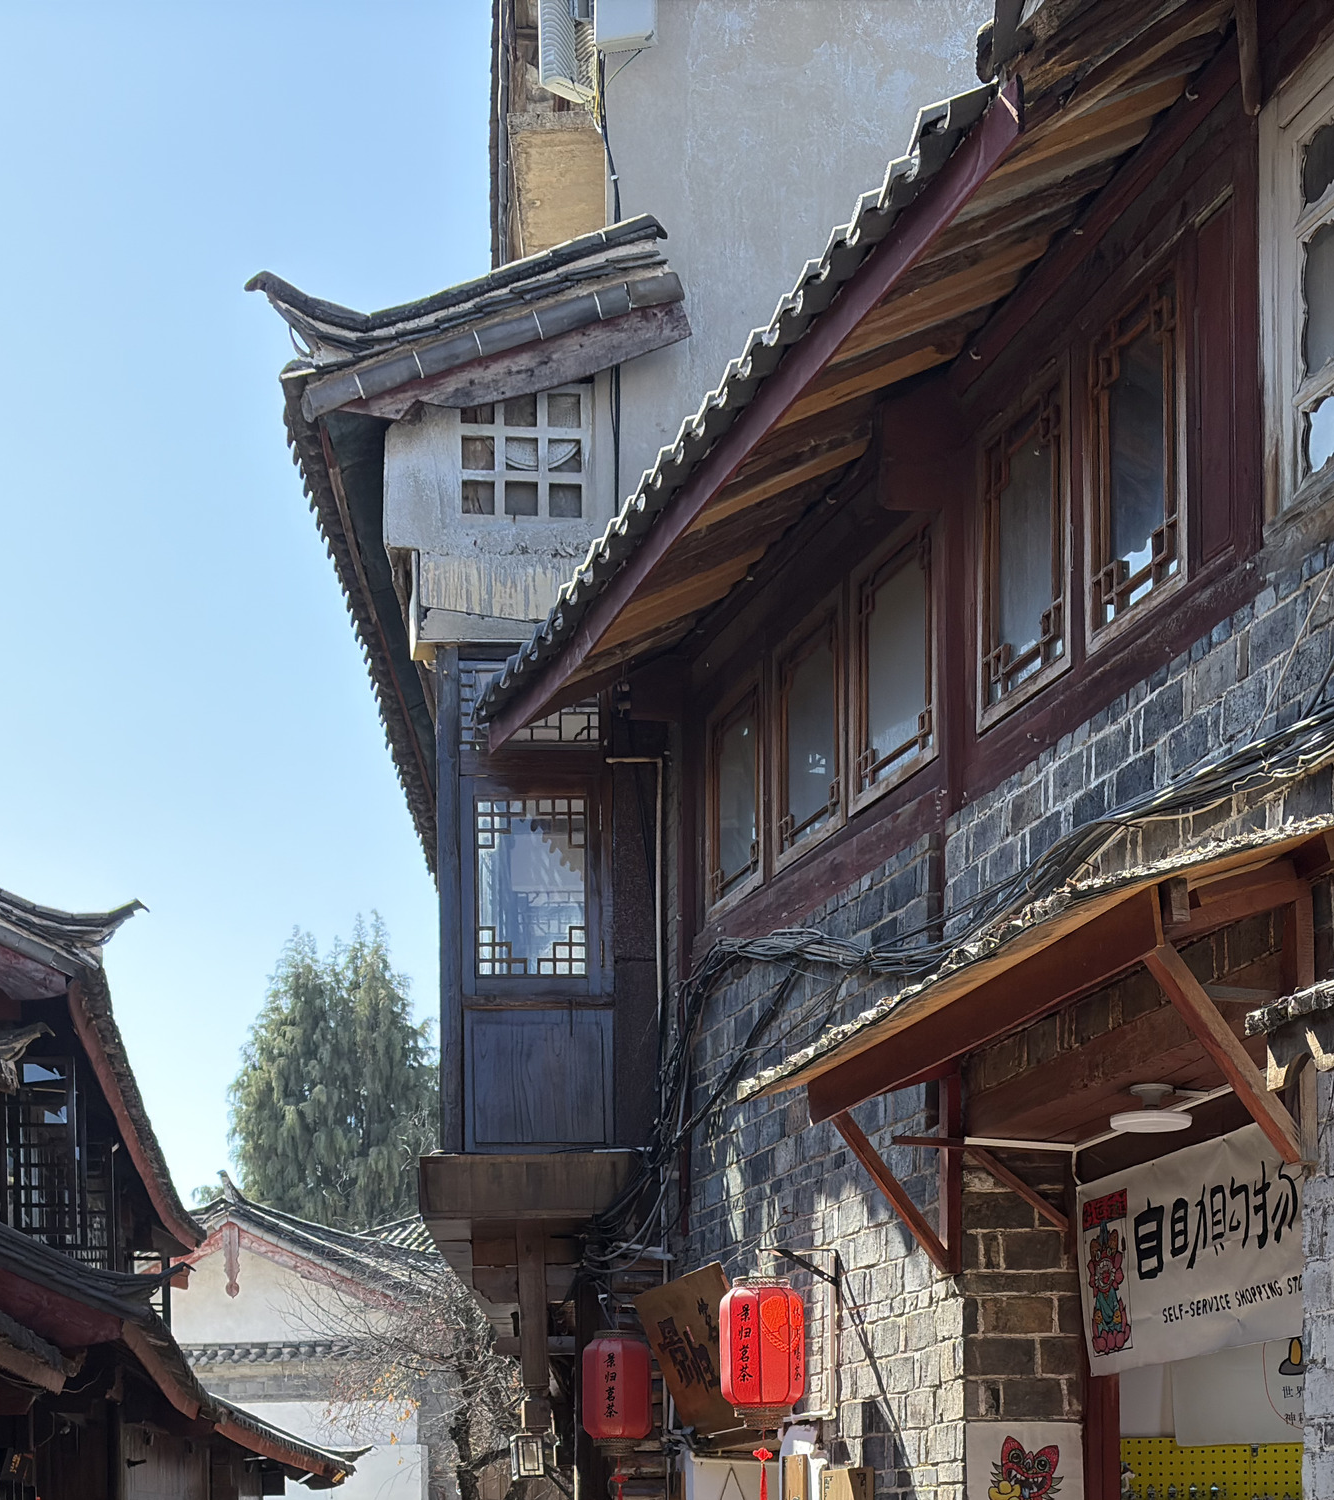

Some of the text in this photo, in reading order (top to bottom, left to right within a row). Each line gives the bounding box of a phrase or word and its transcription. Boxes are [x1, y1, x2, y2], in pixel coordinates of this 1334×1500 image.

[1161, 1292, 1232, 1324] SELF-SERVICE
[1234, 1279, 1283, 1308] SHOPPING
[737, 1303, 754, 1383] 景归茗茶
[603, 1352, 619, 1419] 景归茗茶
